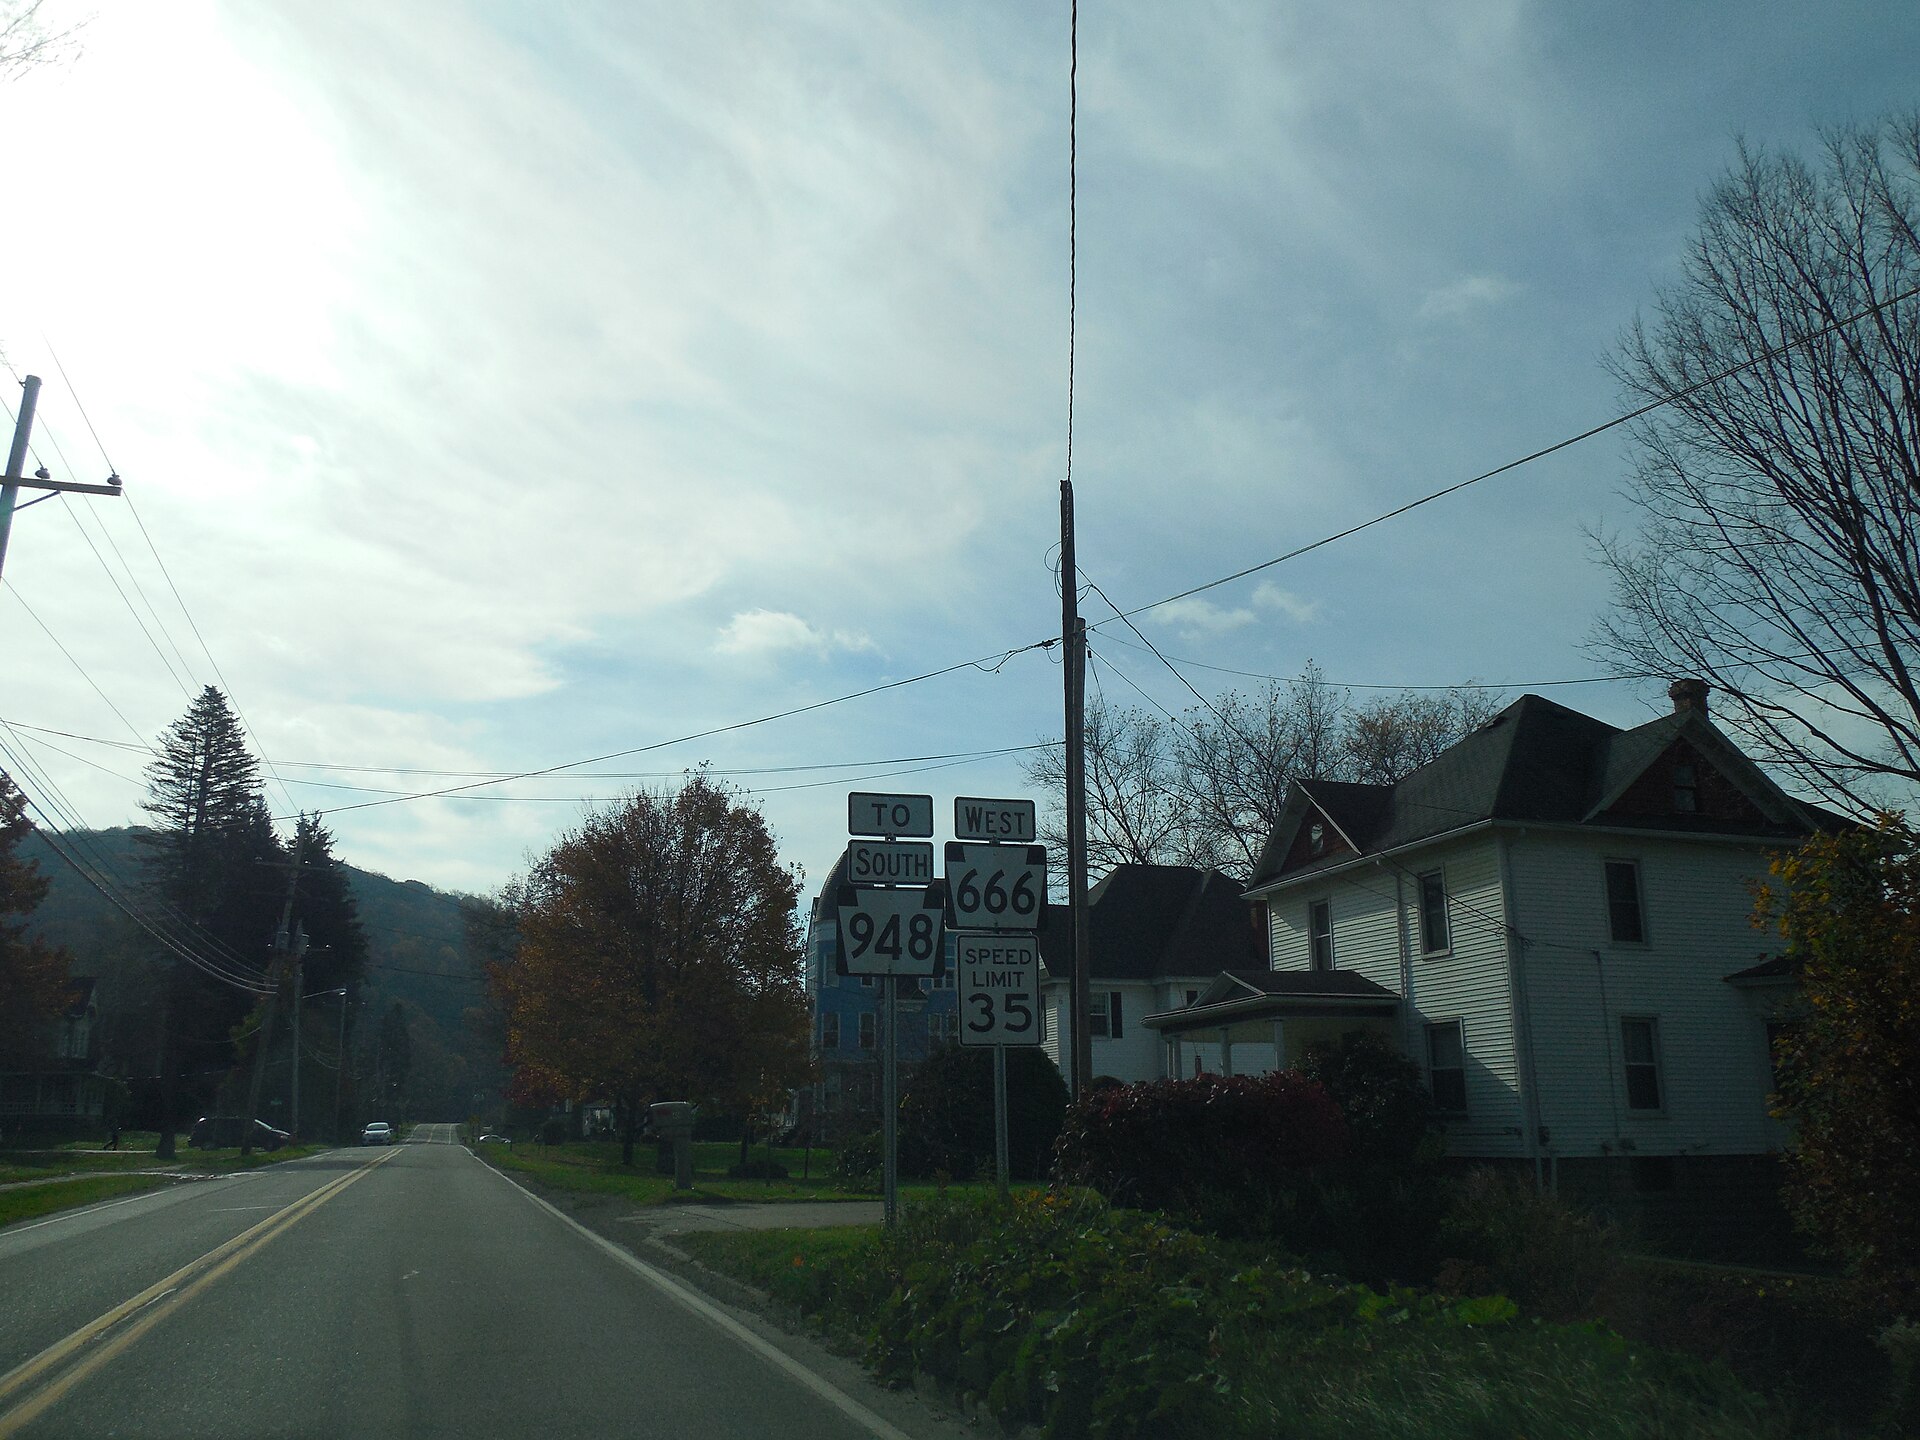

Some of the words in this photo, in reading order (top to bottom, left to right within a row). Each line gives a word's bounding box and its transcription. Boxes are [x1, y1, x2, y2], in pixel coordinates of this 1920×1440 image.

[871, 803, 911, 827] TO
[965, 806, 1025, 835] WEST
[855, 848, 928, 877] SOUTH
[957, 868, 1036, 915] 666
[849, 912, 933, 961] 948
[965, 948, 1032, 965] SPEED
[972, 971, 1025, 988] LIMIT
[967, 993, 1033, 1033] 35
